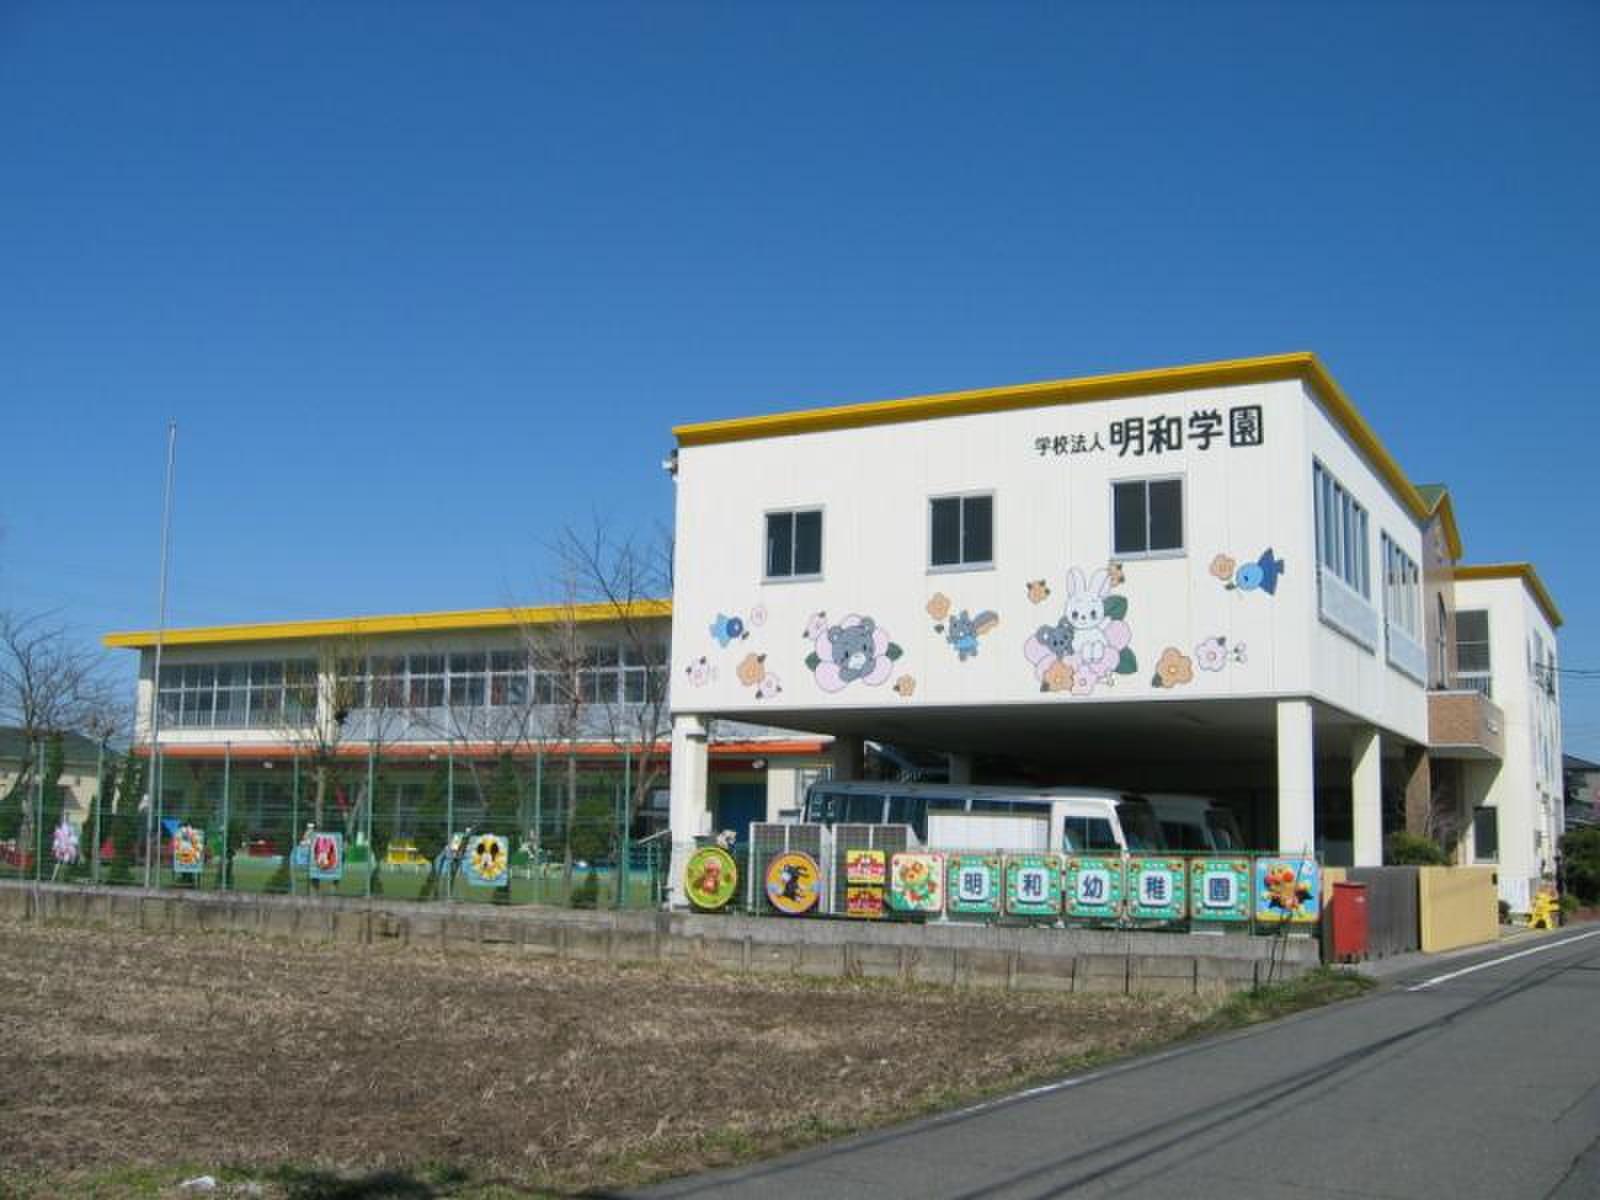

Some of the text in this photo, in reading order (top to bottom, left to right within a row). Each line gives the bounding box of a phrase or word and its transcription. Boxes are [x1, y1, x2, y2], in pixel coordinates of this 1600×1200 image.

[1034, 405, 1264, 457] 学校法人 明和学園
[963, 872, 1231, 901] 明和幼稚園
